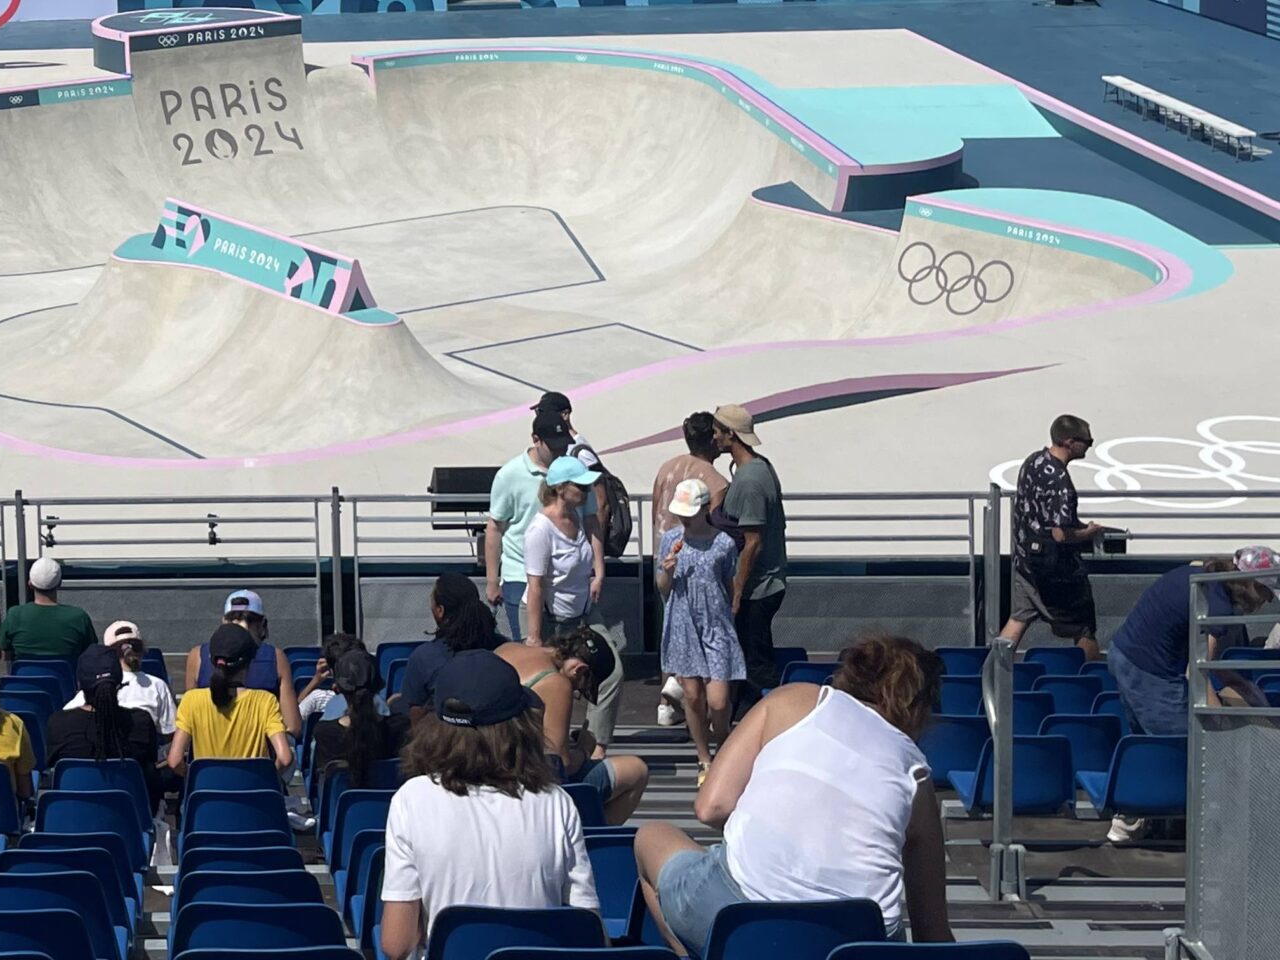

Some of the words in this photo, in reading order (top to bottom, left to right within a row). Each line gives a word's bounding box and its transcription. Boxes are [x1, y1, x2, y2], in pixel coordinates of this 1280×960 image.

[187, 29, 225, 44] PARIS
[230, 25, 264, 39] 2024
[57, 88, 86, 99] PARIS
[88, 85, 114, 96] 2024
[159, 77, 287, 125] PARiS
[172, 121, 304, 166] 2024
[1007, 225, 1033, 240] PARIS
[1035, 231, 1060, 245] 2024
[248, 249, 280, 273] 2024
